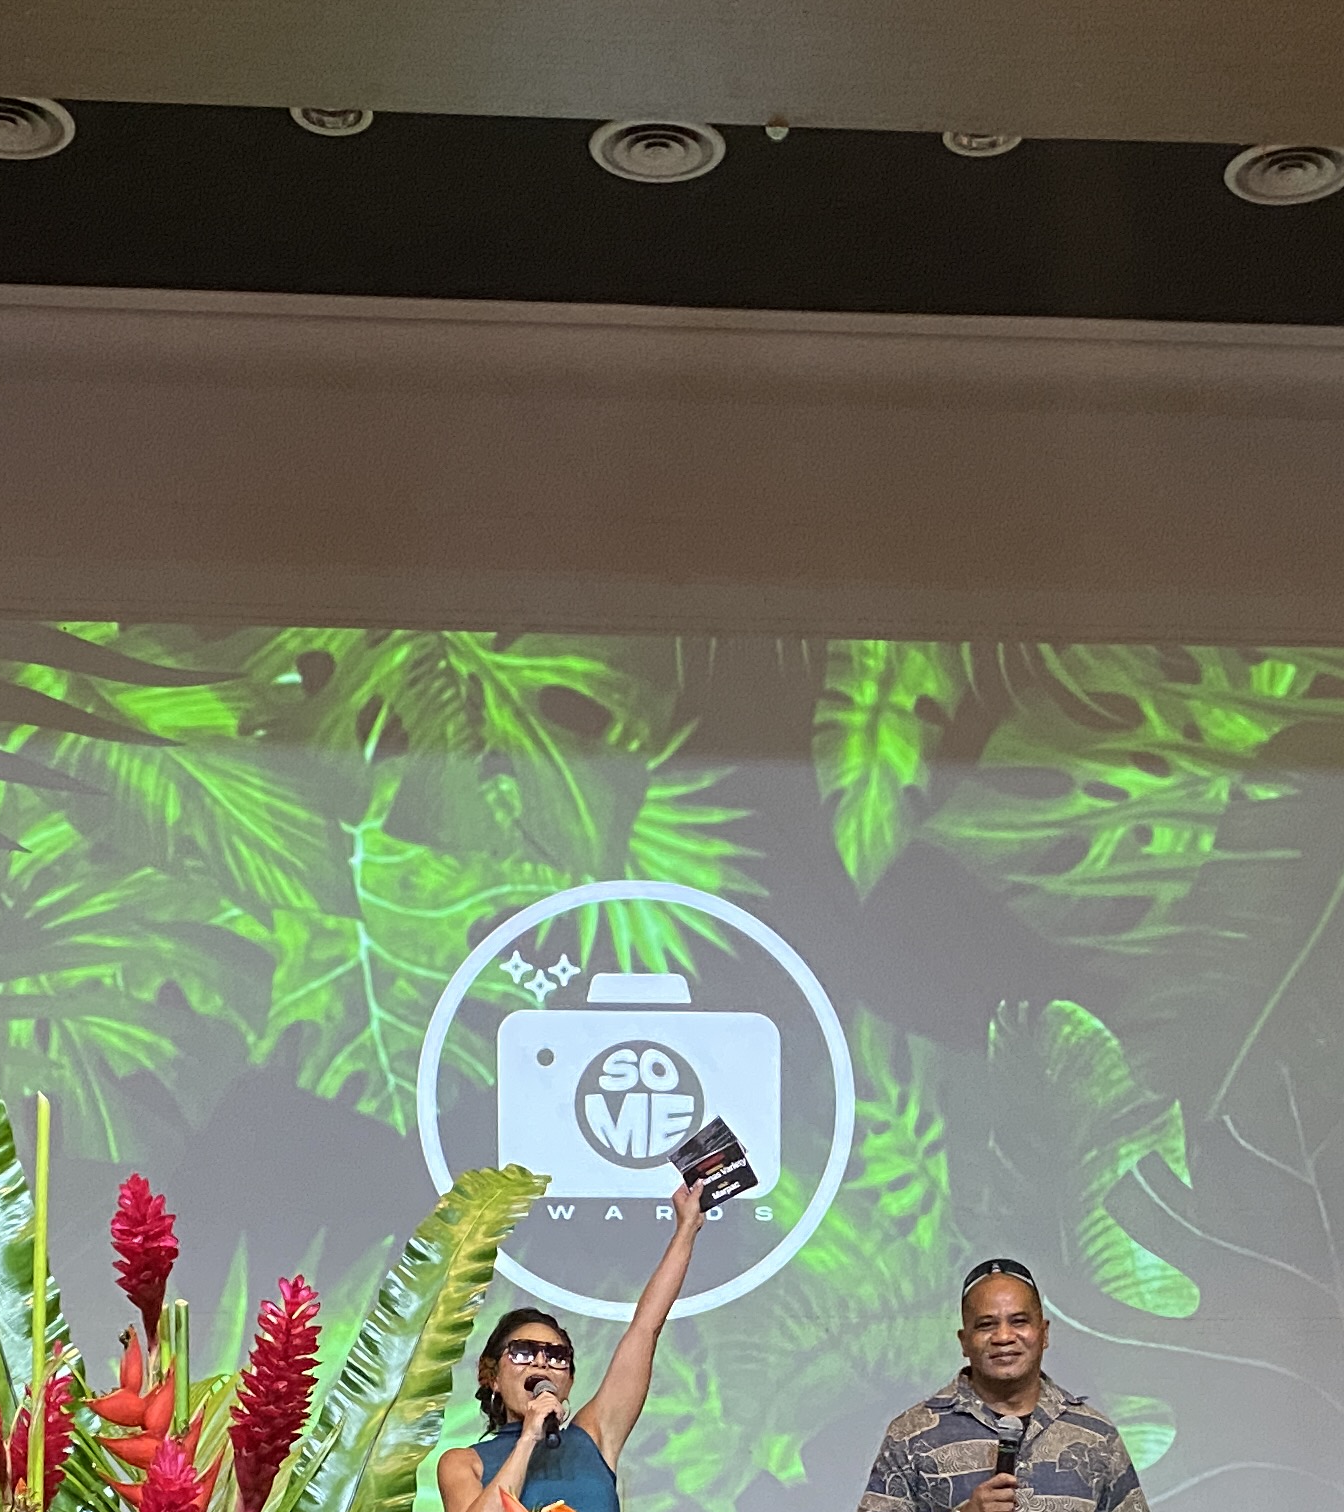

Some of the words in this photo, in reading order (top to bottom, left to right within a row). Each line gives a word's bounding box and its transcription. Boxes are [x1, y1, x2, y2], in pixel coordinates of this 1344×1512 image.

[598, 1048, 679, 1091] SO
[584, 1092, 695, 1159] ME
[547, 1204, 773, 1221] WARDS
